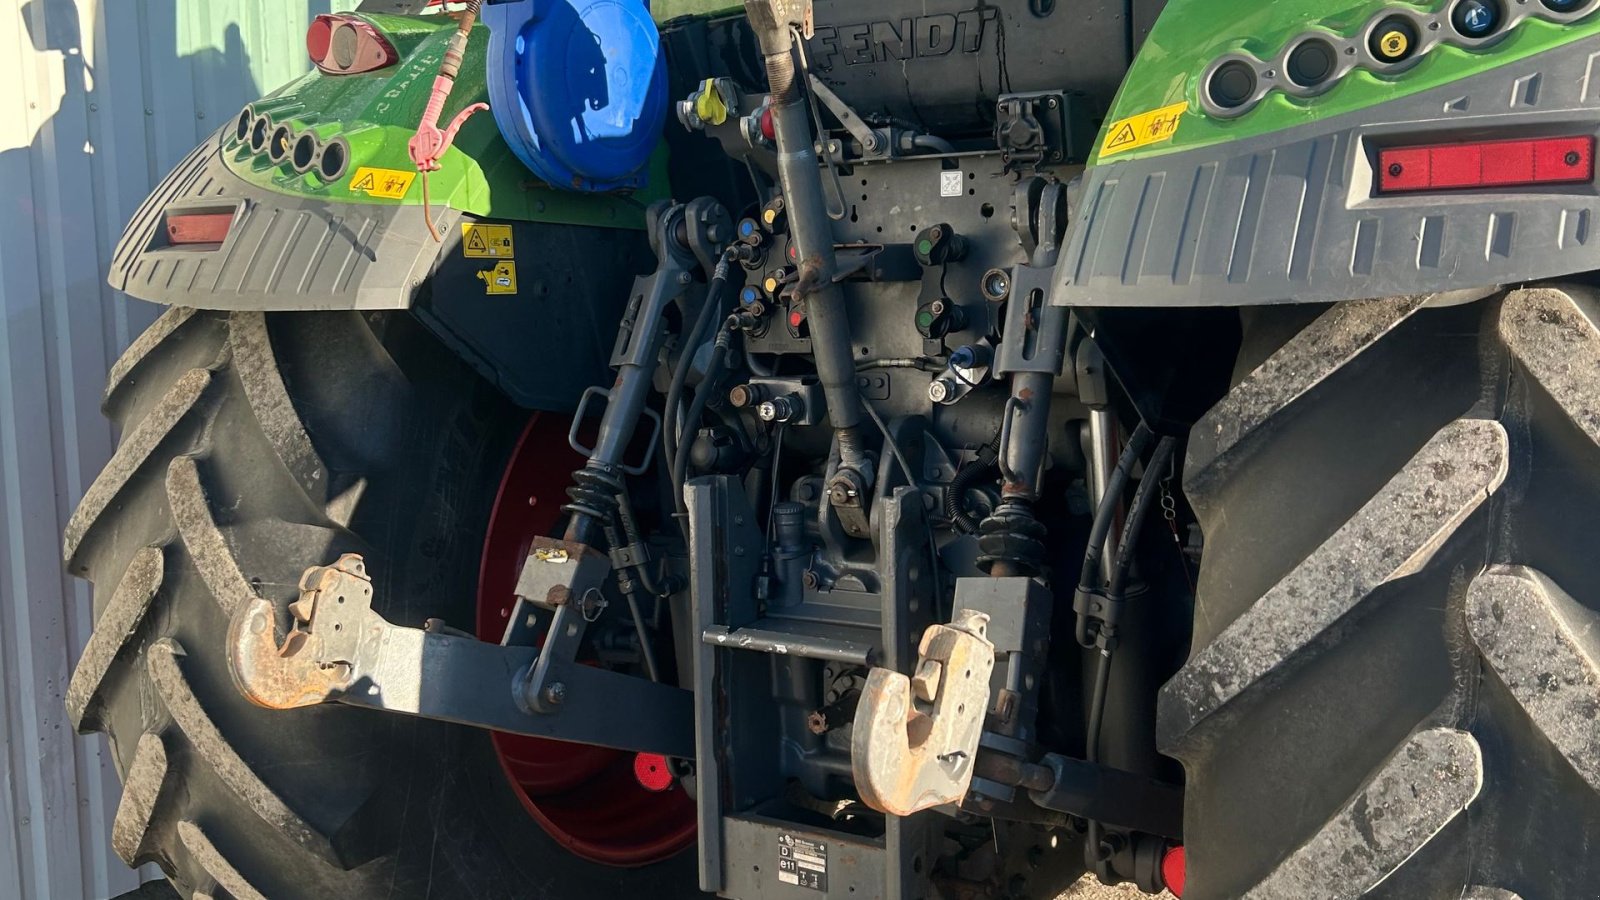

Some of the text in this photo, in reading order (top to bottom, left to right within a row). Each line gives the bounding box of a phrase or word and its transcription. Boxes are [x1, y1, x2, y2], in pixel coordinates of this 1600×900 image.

[809, 7, 998, 70] FENDT
[781, 847, 788, 856] D
[780, 860, 795, 870] e11
